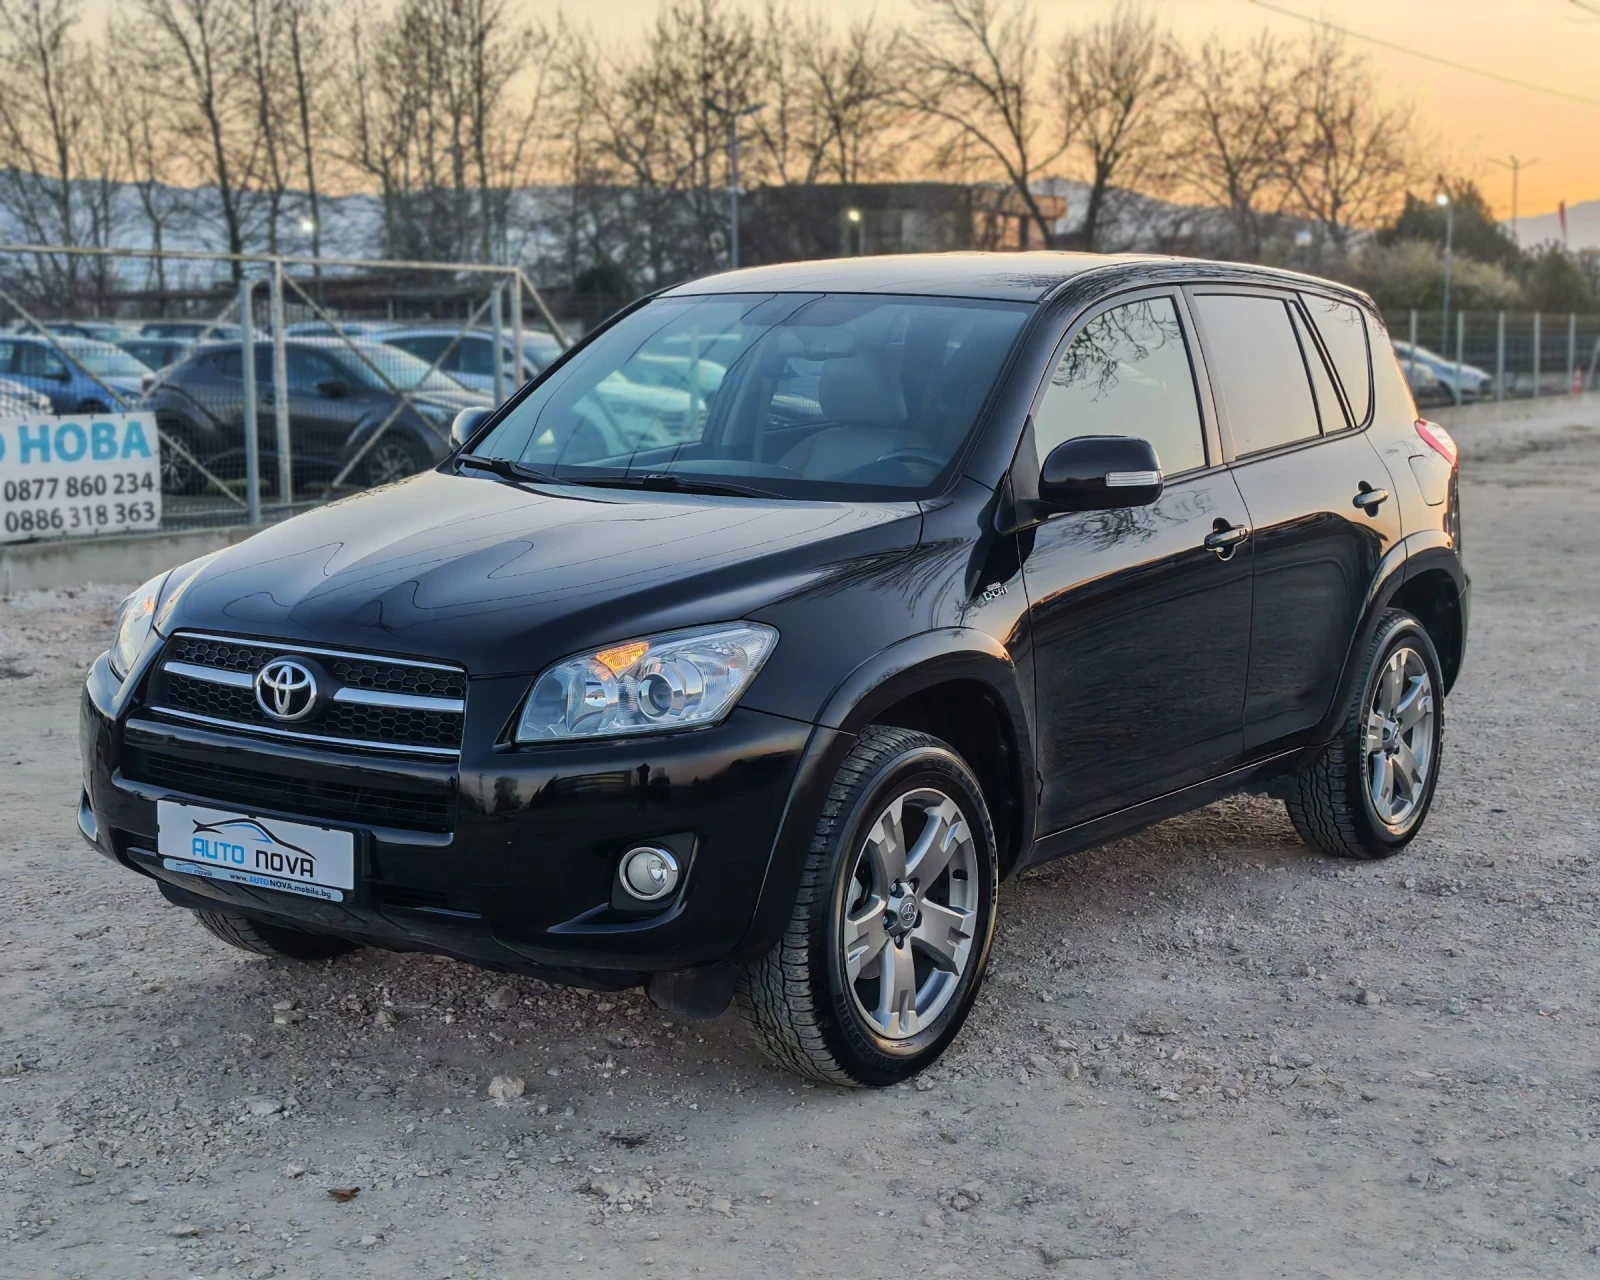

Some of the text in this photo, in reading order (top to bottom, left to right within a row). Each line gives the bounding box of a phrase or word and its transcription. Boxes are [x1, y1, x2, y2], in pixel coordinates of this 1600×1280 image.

[17, 421, 152, 464] НОВА
[4, 472, 154, 502] 0877 860 234
[5, 501, 155, 533] 0886 318 363
[191, 837, 245, 865] AUTO
